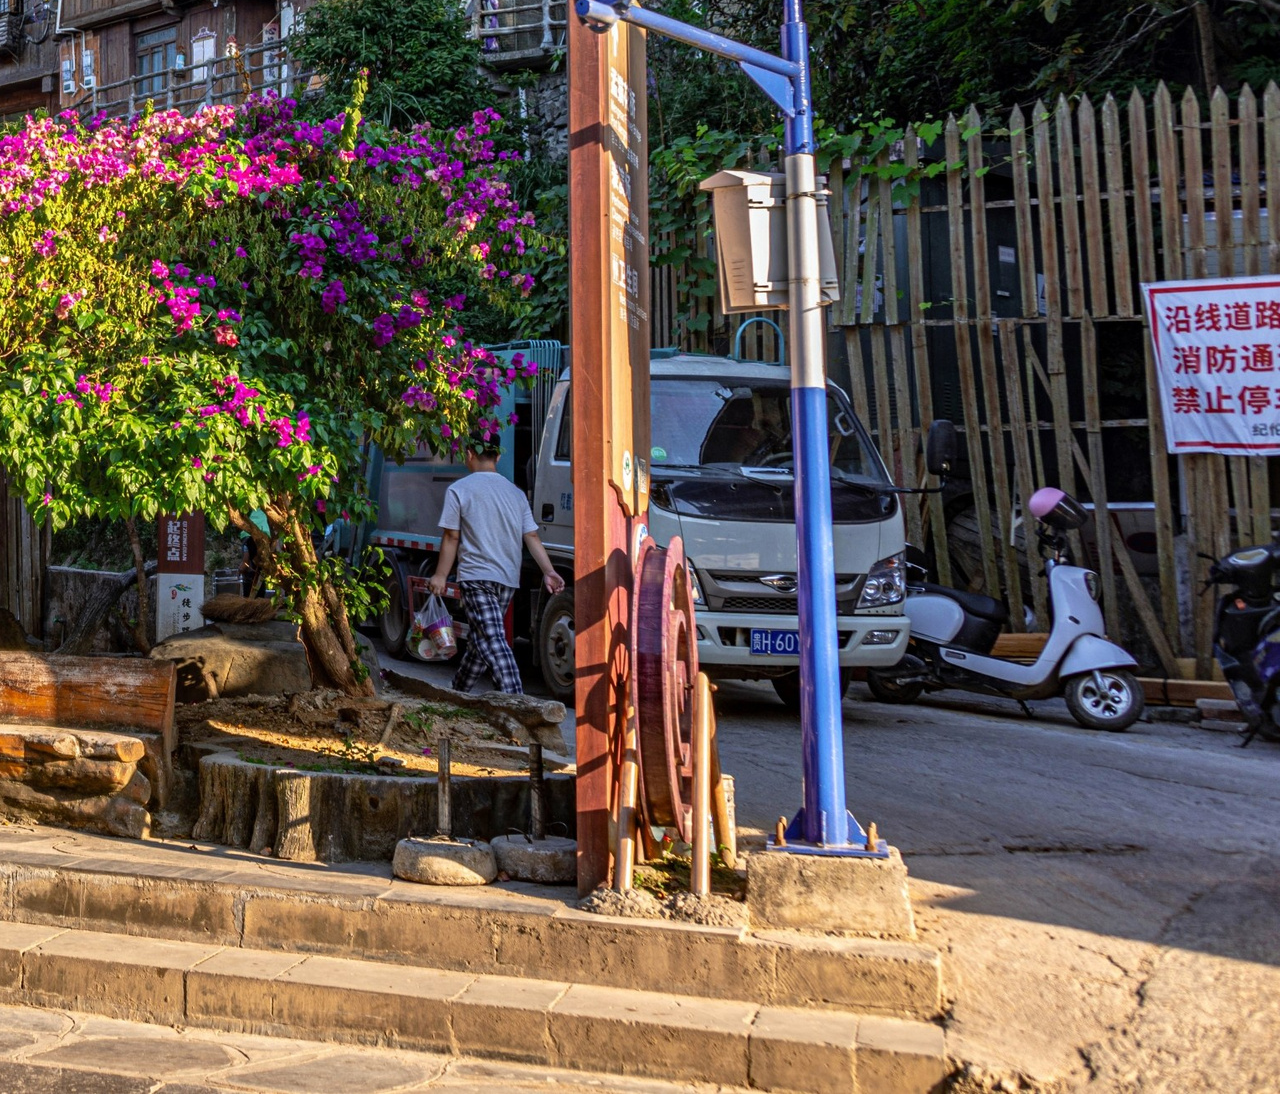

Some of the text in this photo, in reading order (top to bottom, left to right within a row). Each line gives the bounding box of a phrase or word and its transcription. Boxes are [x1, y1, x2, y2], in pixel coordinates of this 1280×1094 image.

[1165, 300, 1280, 334] 沿线道路
[1172, 343, 1280, 375] 消防通
[1171, 385, 1280, 415] 禁止停
[167, 520, 181, 561] 起终点
